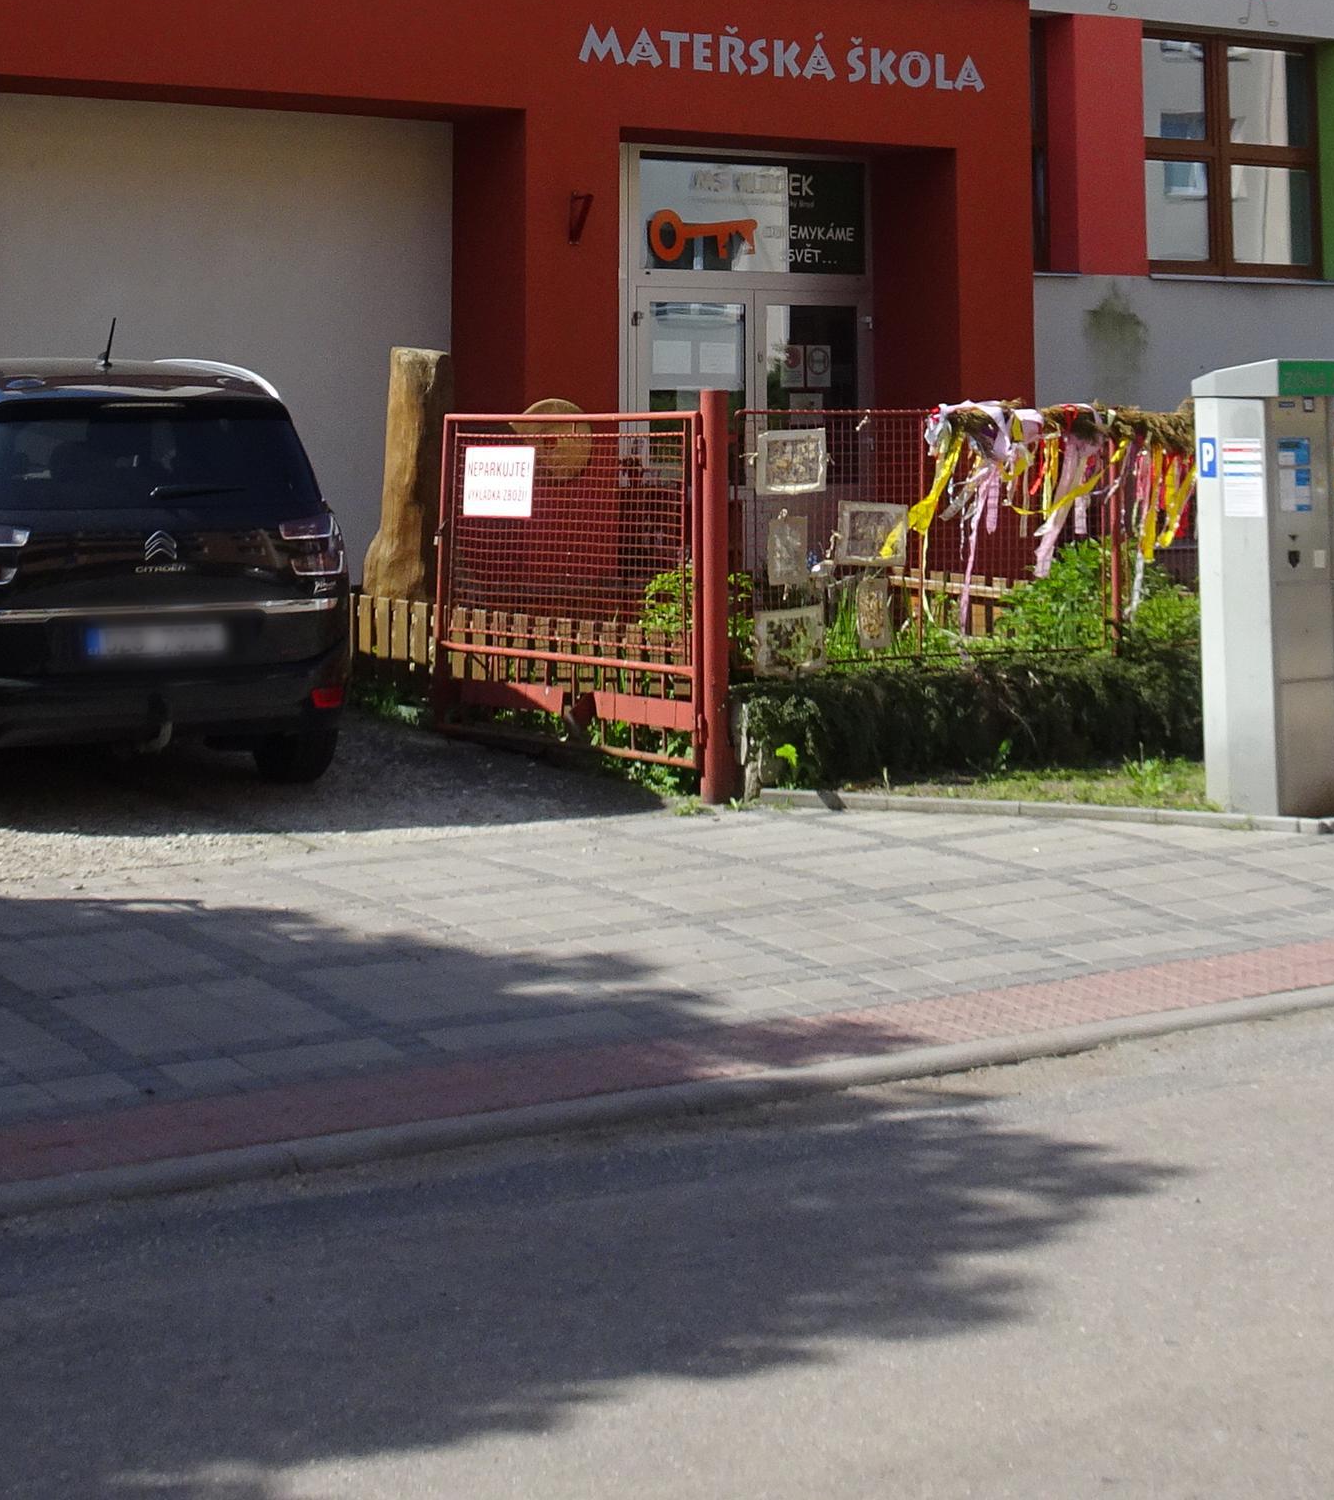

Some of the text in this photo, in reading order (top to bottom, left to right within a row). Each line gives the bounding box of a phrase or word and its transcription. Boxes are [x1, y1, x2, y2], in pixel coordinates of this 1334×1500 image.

[579, 22, 986, 92] MATEŘSKÁ ŠKOLA
[468, 461, 530, 477] NEPARKUJTE!
[1202, 442, 1214, 472] P
